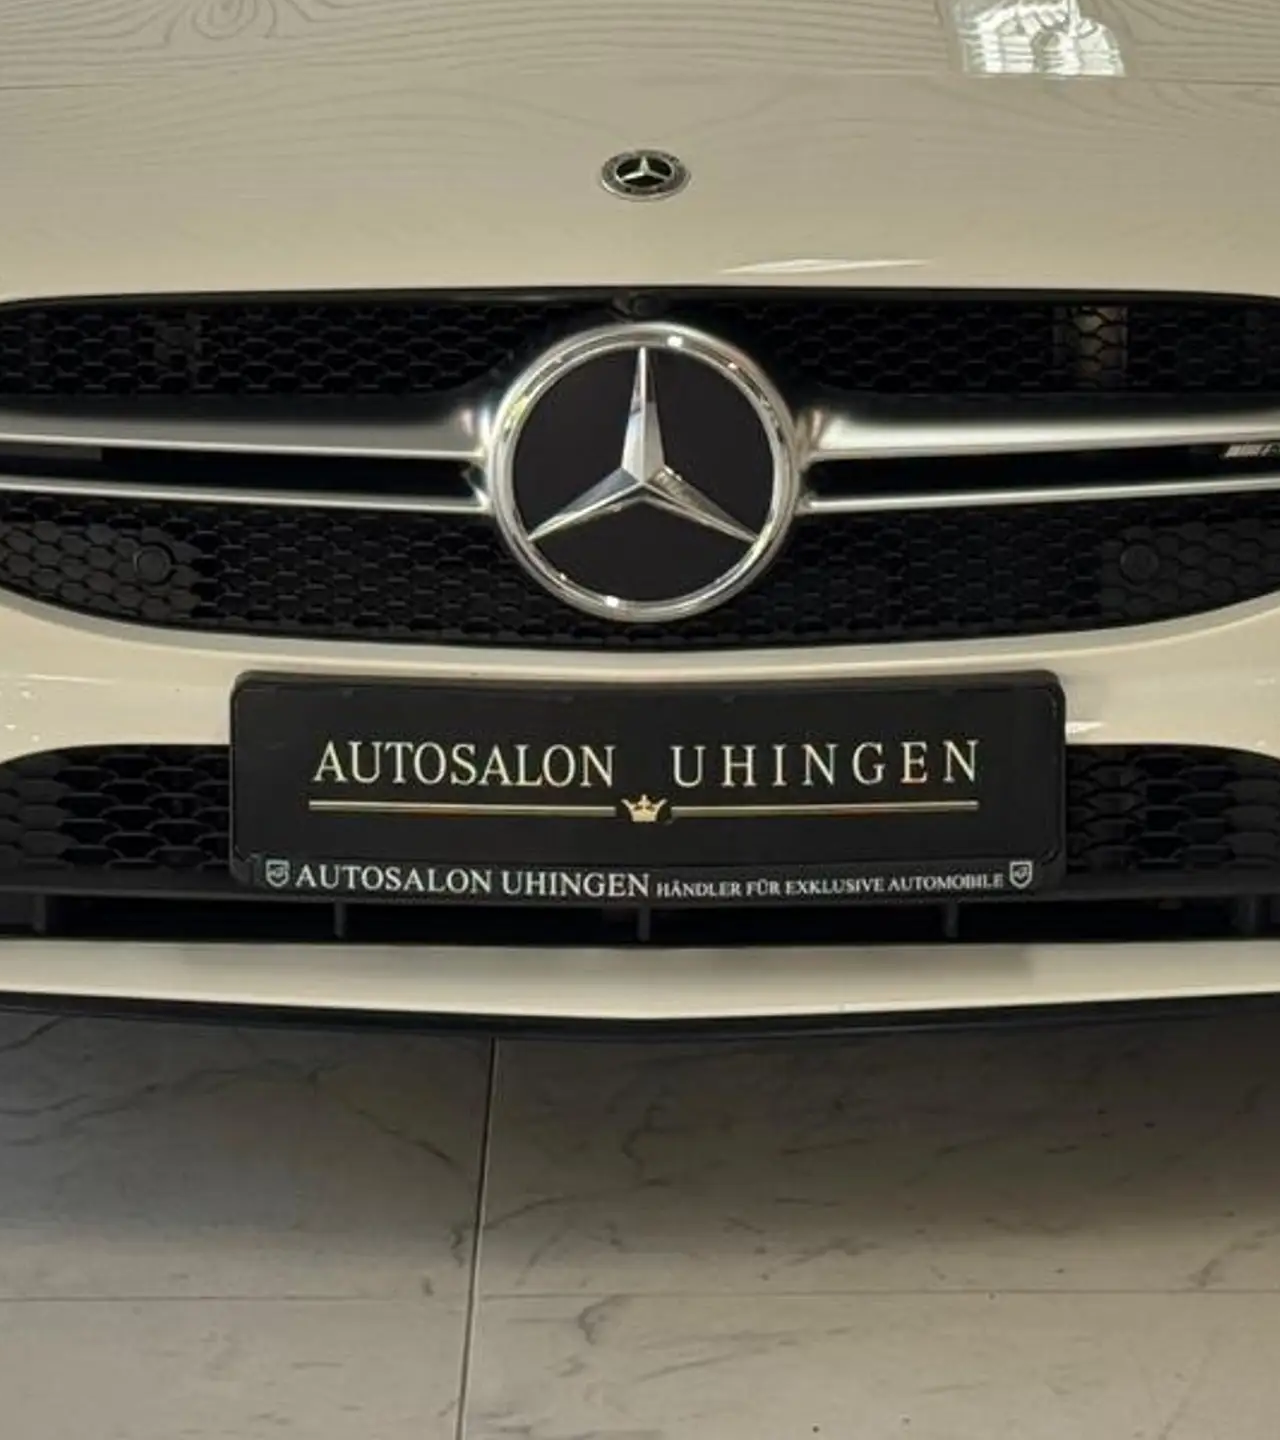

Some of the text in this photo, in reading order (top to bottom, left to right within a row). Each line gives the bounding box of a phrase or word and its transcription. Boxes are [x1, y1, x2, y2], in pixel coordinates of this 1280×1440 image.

[312, 738, 979, 789] AUTOSALON UHINGEN
[294, 862, 493, 895] AUTOSALON
[500, 868, 650, 898] UHINGEN
[656, 879, 742, 898] HÄNDLER
[745, 877, 781, 896] FÜR
[784, 875, 885, 896] EXKLUSIVE
[887, 872, 1004, 893] AUTOMOBILE
